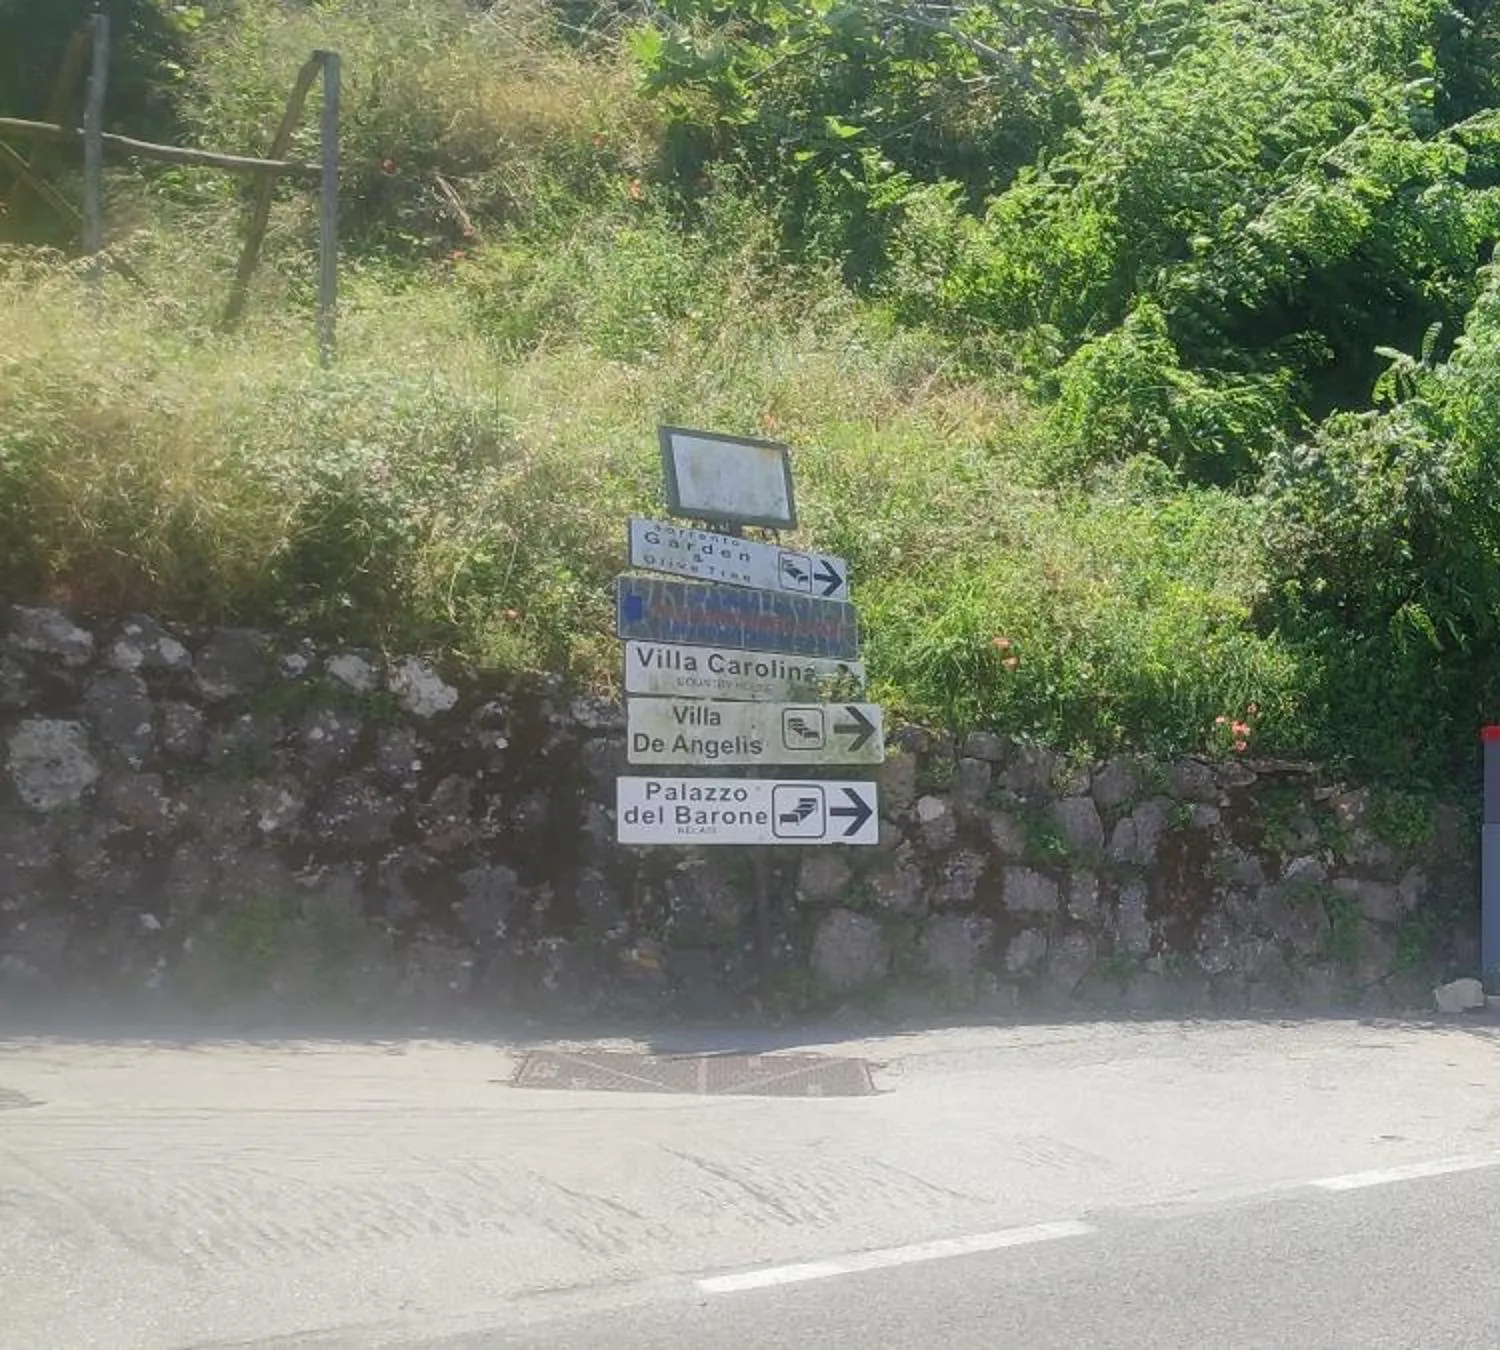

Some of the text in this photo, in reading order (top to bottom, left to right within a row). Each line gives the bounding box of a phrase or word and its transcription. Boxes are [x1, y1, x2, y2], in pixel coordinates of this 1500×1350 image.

[644, 532, 750, 562] Garden
[643, 554, 699, 573] Olive
[637, 647, 697, 671] Villa
[673, 706, 721, 726] Villa
[634, 734, 763, 759] De Angelis
[645, 782, 748, 801] Palazzo
[624, 805, 768, 825] del Barone
